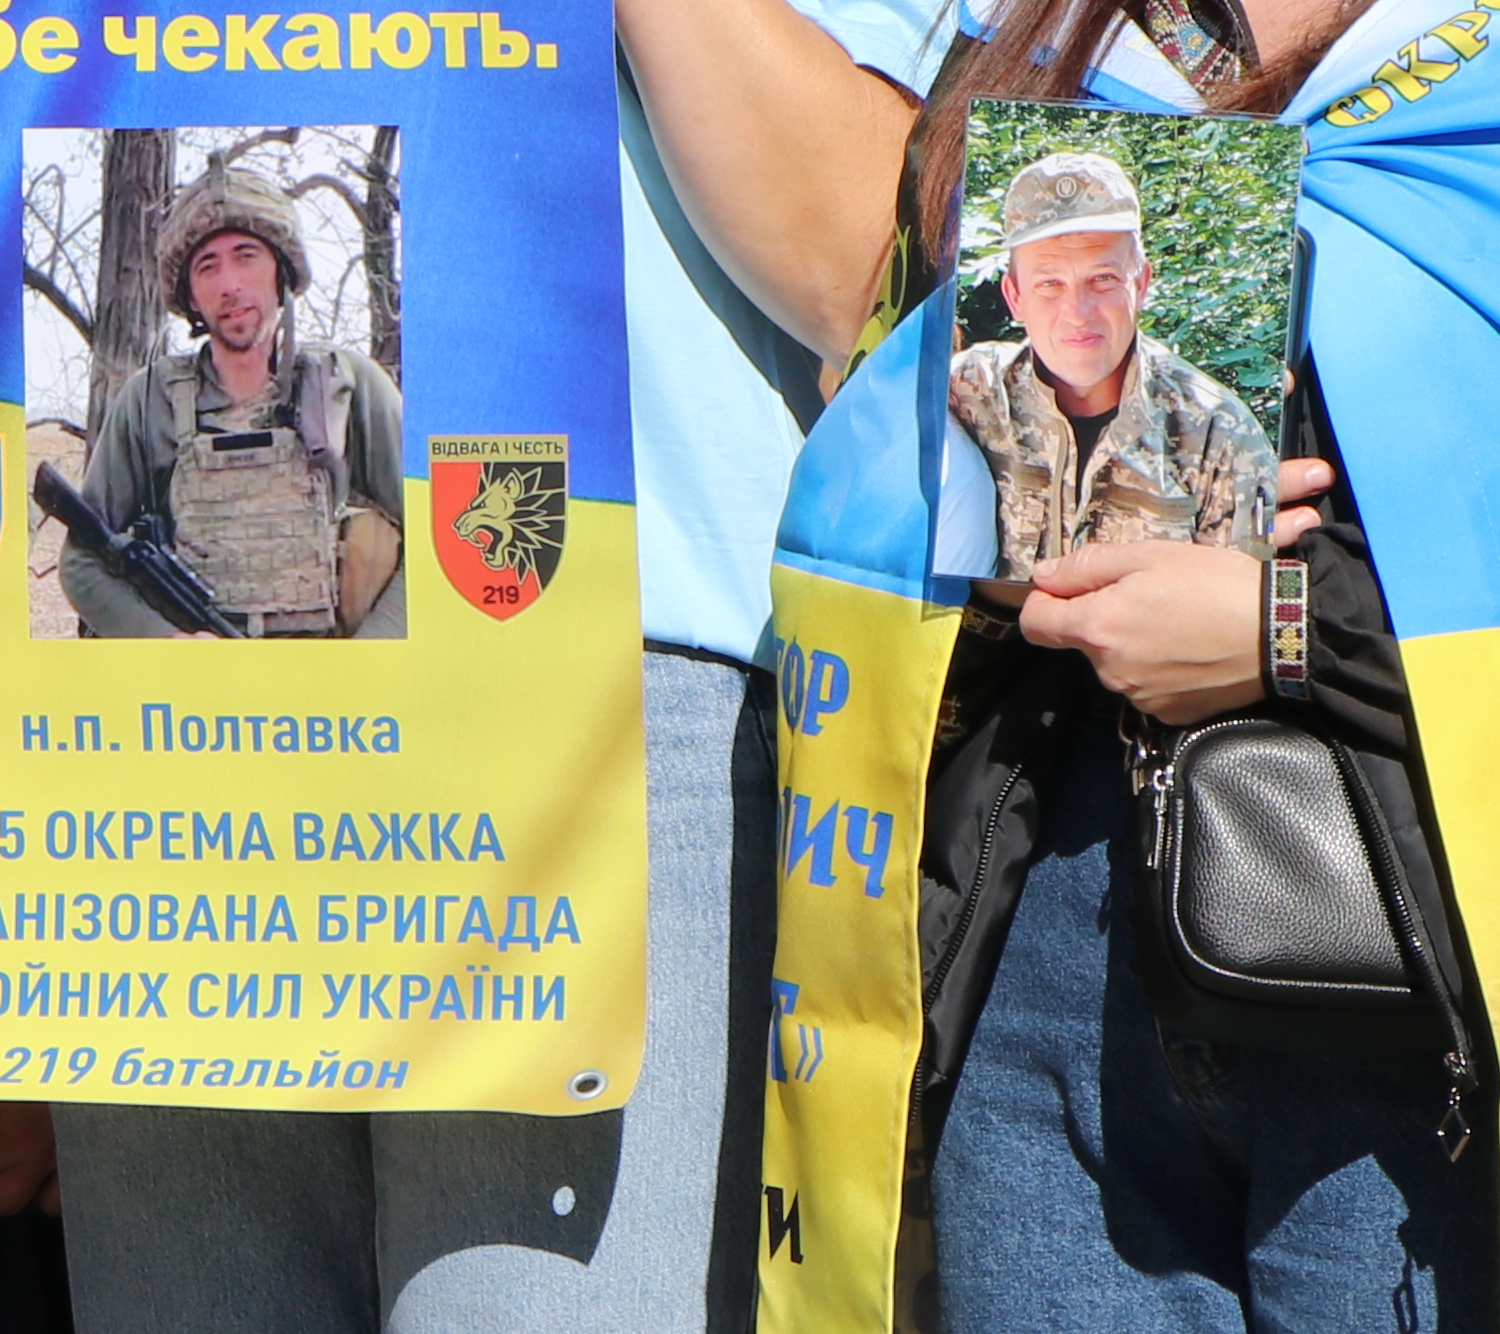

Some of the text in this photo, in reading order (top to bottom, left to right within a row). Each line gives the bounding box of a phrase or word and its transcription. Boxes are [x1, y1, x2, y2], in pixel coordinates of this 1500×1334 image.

[102, 11, 558, 73] чекають.
[432, 442, 500, 457] ВІДВАГА
[512, 441, 564, 455] ЧЕСТЬ
[483, 585, 520, 604] 219
[21, 703, 402, 754] н.п. Полтавка
[45, 810, 276, 863] ОКРЕМА
[293, 810, 505, 864] ВАЖКА
[317, 894, 582, 952] БРИГАДА
[187, 970, 302, 1020] СИЛ
[321, 964, 568, 1022] УКРАЇНИ
[111, 1045, 408, 1089] батальйон
